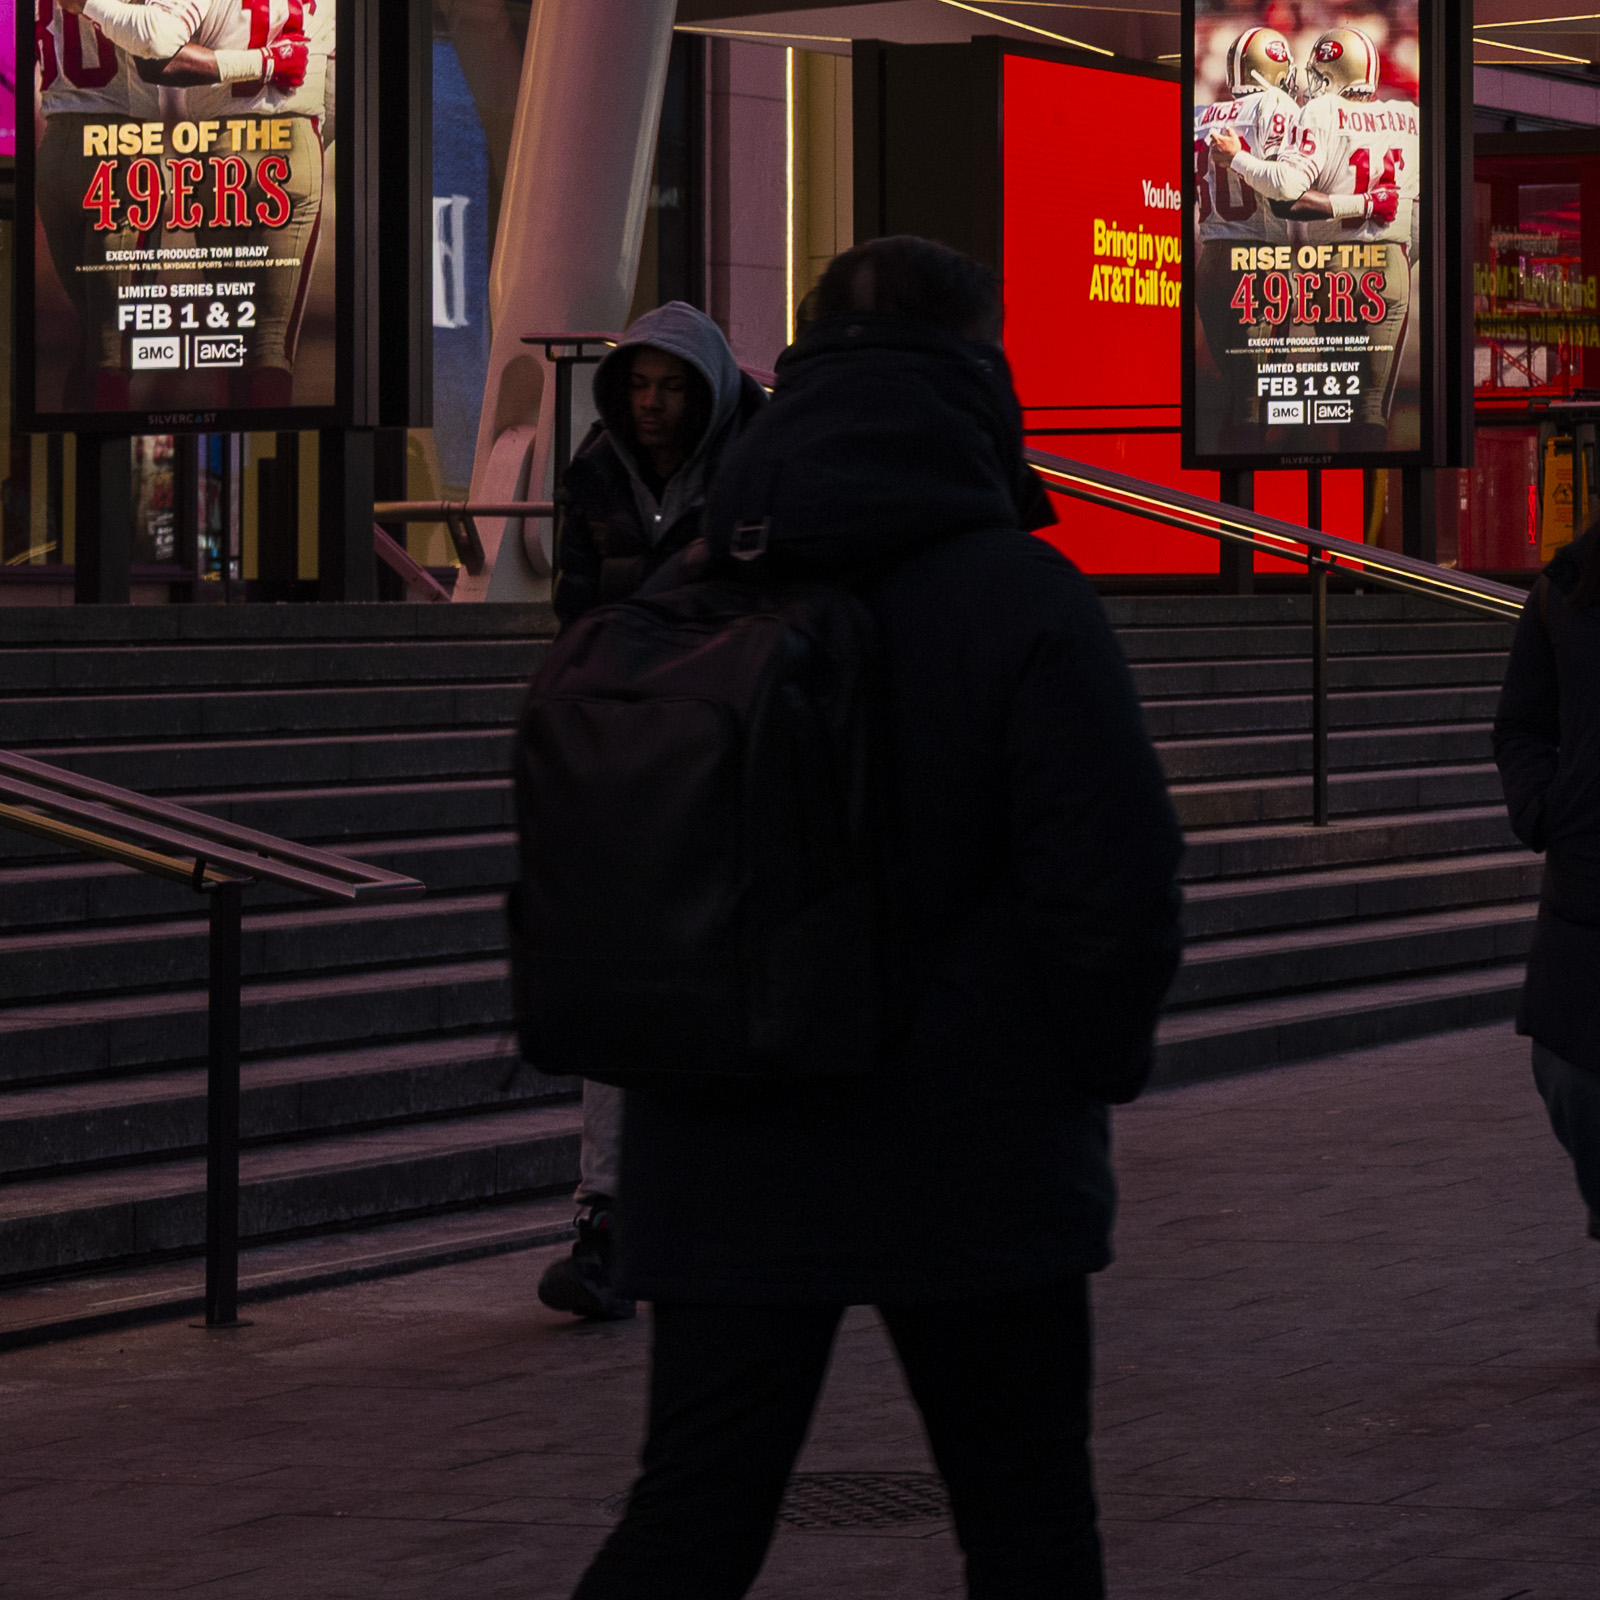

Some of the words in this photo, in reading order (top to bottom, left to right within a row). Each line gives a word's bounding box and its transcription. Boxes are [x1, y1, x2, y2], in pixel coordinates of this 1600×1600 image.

[1201, 101, 1243, 125] RICE
[1337, 108, 1418, 136] MONTANA
[84, 122, 164, 156] RISE
[172, 120, 220, 154] OF
[227, 118, 292, 151] THE
[82, 155, 292, 231] 49ERS
[1142, 179, 1164, 209] You
[106, 249, 155, 262] EXECUTIVE
[157, 248, 208, 260] PRODUCER
[210, 247, 232, 258] TOM
[235, 246, 269, 258] BRADY
[1094, 218, 1137, 267] Bring
[1139, 224, 1154, 261] in
[1231, 246, 1291, 271] RISE
[1297, 245, 1333, 269] OF
[1338, 244, 1387, 268] THE
[118, 285, 167, 299] LIMITED
[170, 284, 213, 297] SERIES
[216, 282, 255, 296] EVENT
[1089, 264, 1134, 303] AT&T
[1135, 268, 1159, 306] bill
[1230, 271, 1387, 325] 49ERS
[118, 303, 172, 331] FEB
[180, 303, 199, 329] 1
[206, 302, 229, 329] &
[237, 301, 256, 328] 2
[1286, 337, 1324, 346] PRODUCER
[1326, 336, 1342, 345] TOM
[1344, 335, 1370, 345] BRADY
[1257, 363, 1295, 373] LIMITED
[1296, 362, 1329, 373] SERIES
[1330, 362, 1360, 372] EVENT
[1257, 377, 1298, 397] FEB
[1303, 376, 1318, 395] 1
[1323, 376, 1341, 395] &
[1346, 375, 1360, 395] 2
[148, 413, 217, 424] SILVERCAST
